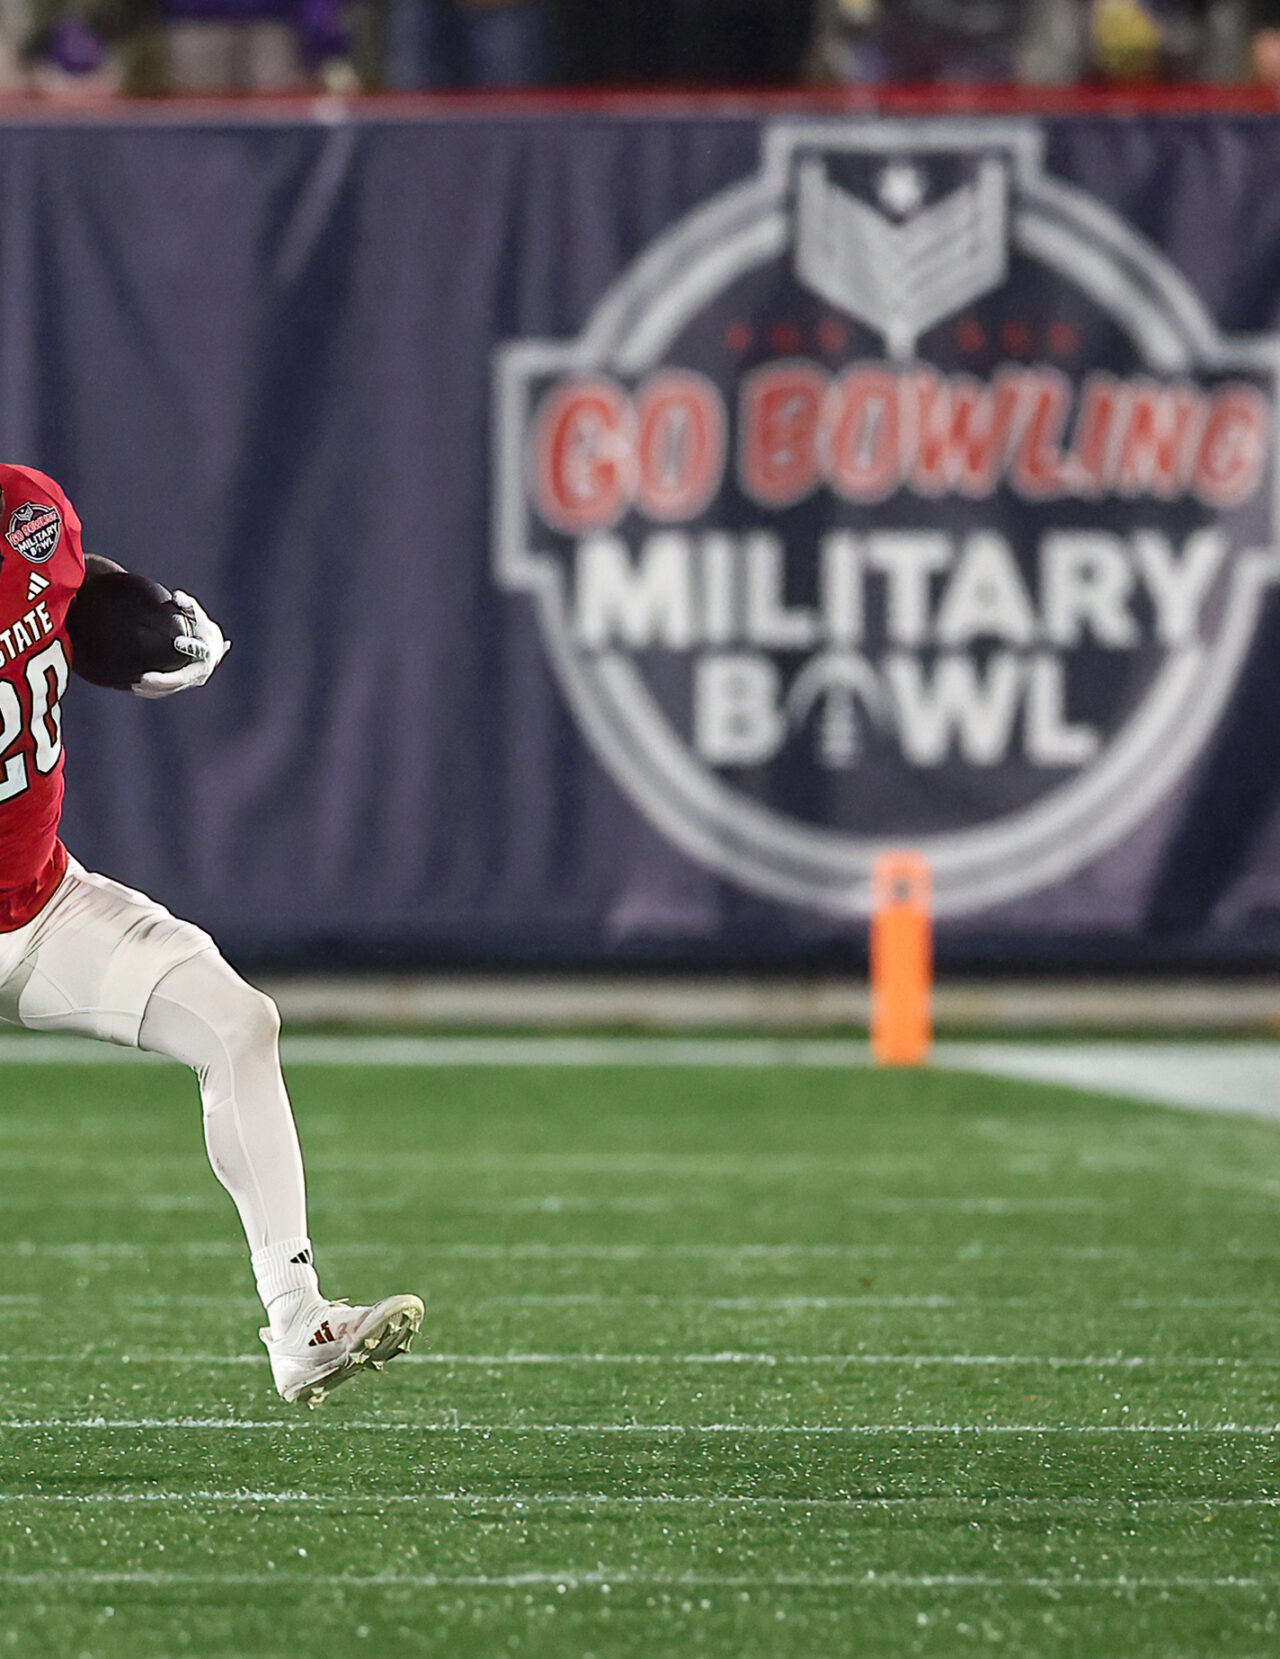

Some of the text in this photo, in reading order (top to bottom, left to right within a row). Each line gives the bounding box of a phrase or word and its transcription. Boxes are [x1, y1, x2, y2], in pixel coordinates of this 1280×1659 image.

[537, 360, 1266, 531] GO BOWLING
[17, 522, 57, 552] MILITARY
[576, 528, 1225, 648] MILITARY
